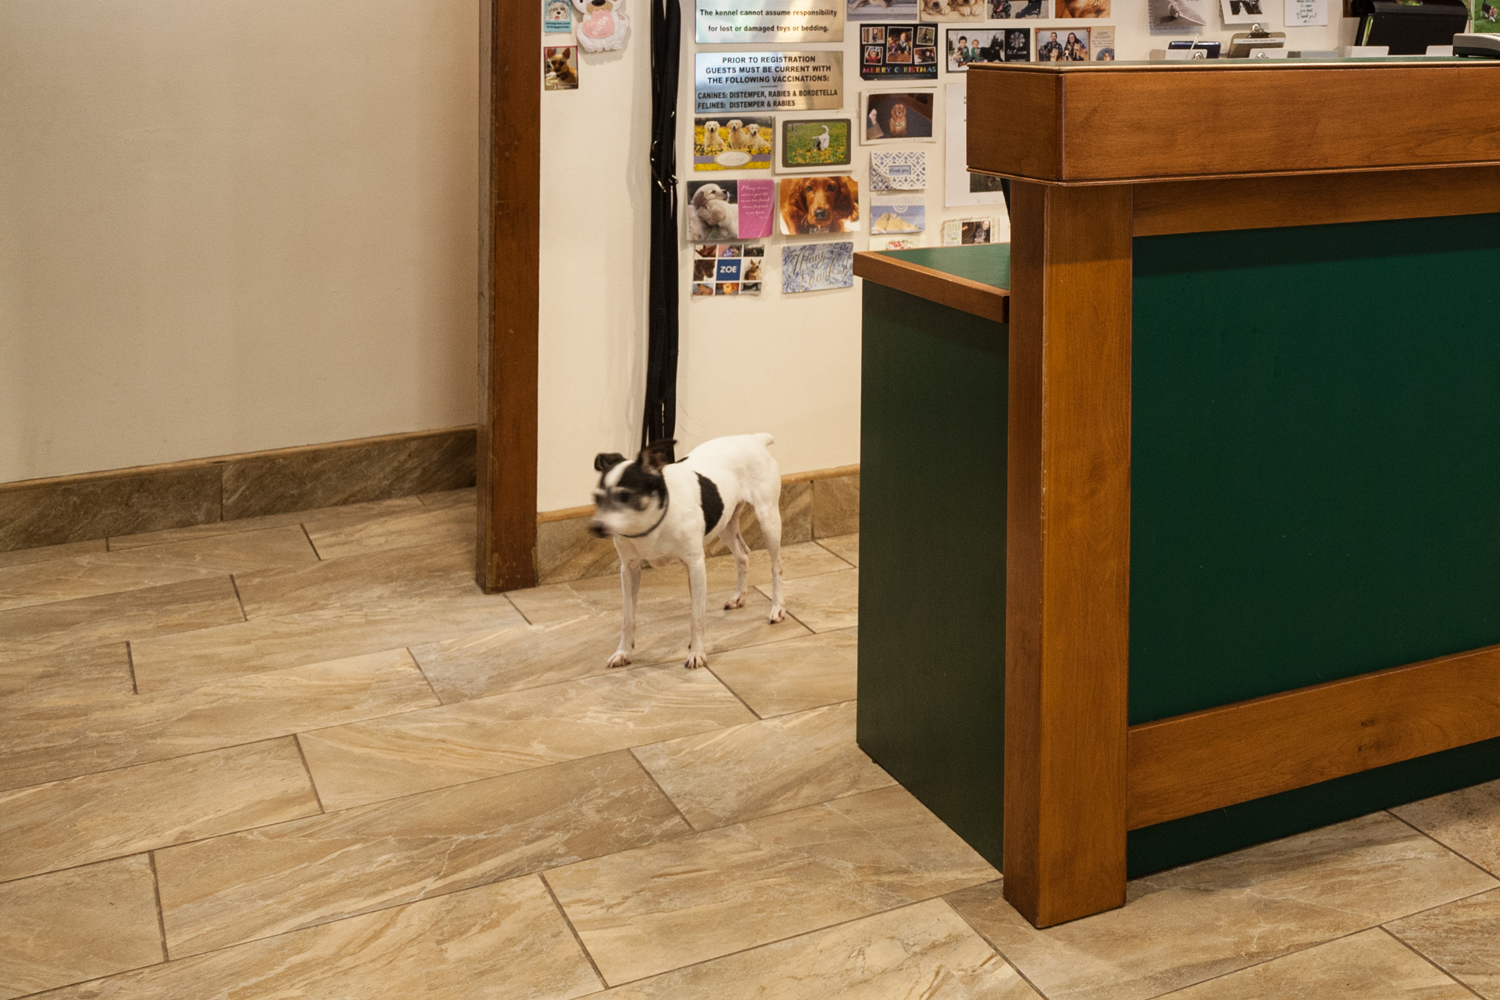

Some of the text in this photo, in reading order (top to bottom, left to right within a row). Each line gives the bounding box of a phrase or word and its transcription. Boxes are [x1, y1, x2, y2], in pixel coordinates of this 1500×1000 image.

[792, 9, 837, 17] responsibility
[592, 15, 608, 35] cutie
[744, 25, 774, 33] damaged
[776, 25, 790, 33] toys
[801, 25, 829, 33] bedding.
[775, 65, 811, 73] CURRENT
[725, 76, 770, 84] FOLLOWING
[772, 75, 830, 83] VACCINATIONS:
[729, 91, 767, 99] DISTEMPER,
[799, 89, 838, 97] BORDETELLA
[697, 102, 726, 110] FELINES:
[729, 101, 765, 109] DISTEMPER
